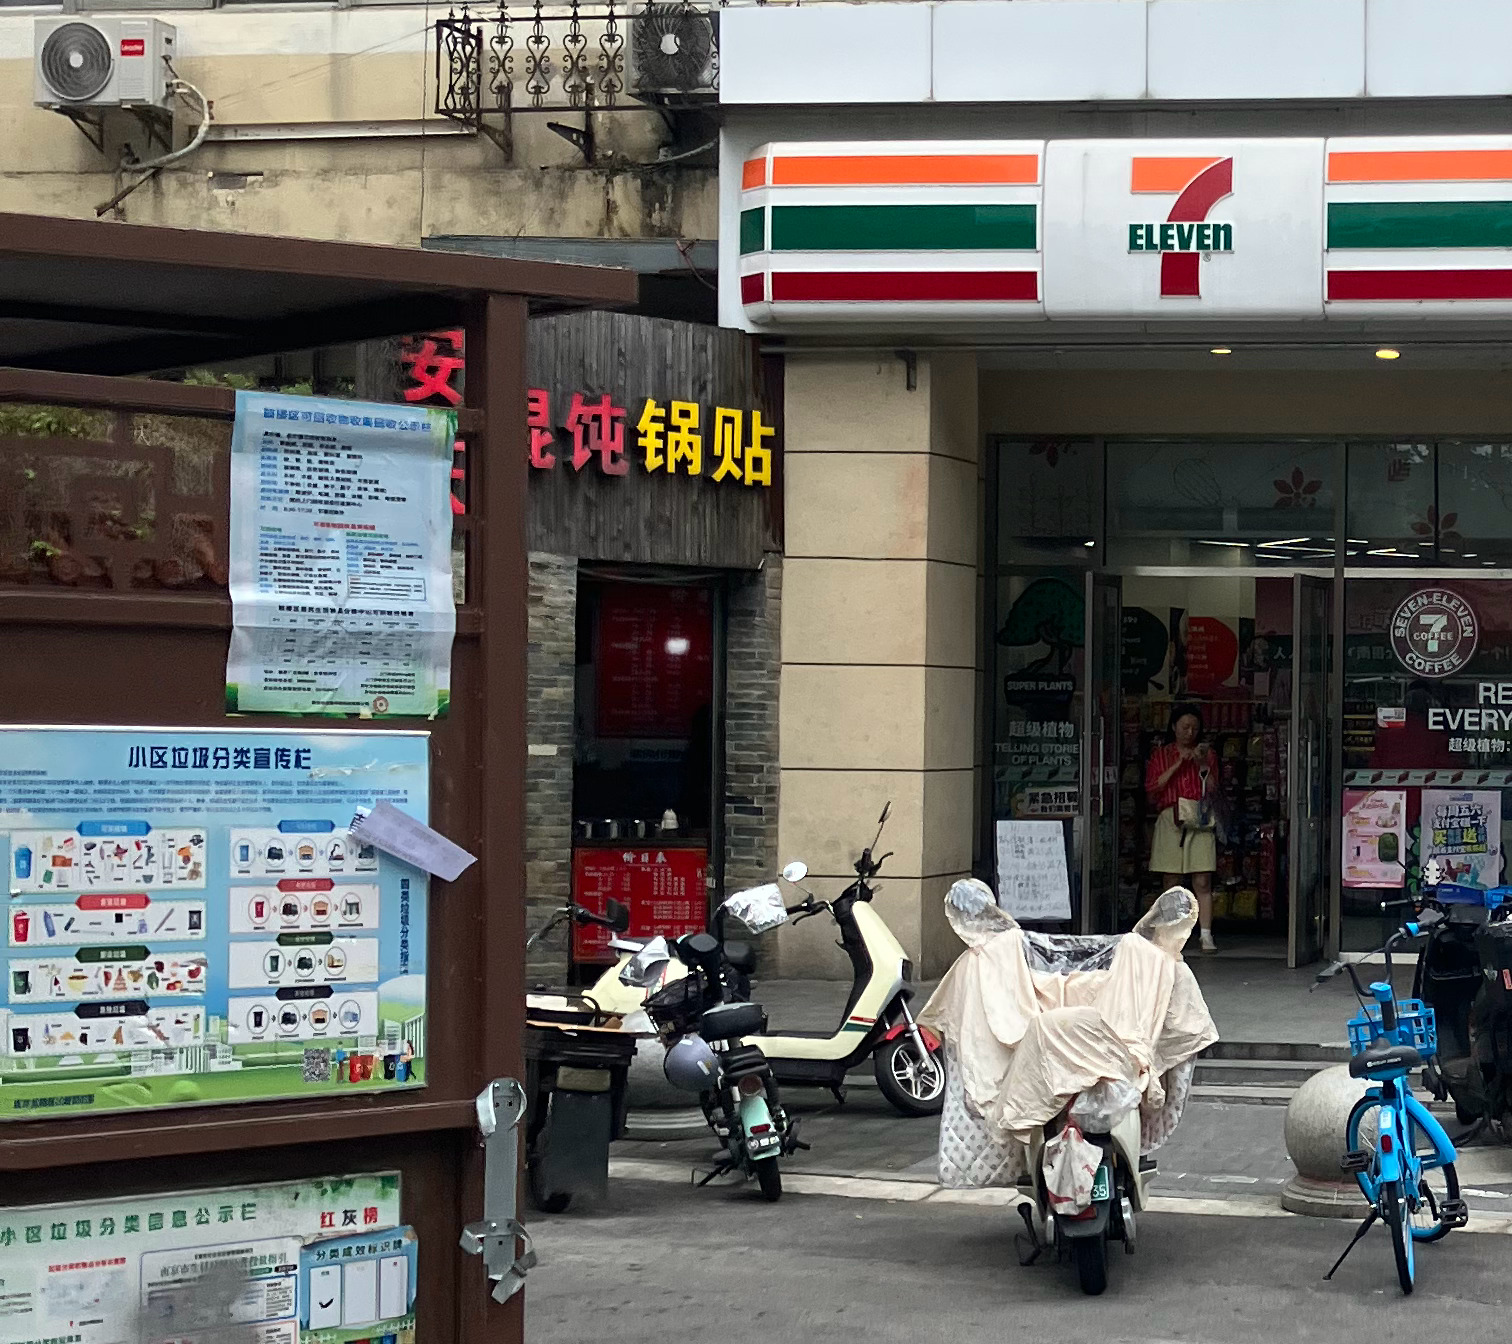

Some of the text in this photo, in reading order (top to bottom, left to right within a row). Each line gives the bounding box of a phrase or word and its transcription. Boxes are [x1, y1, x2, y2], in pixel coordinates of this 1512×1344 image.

[1405, 652, 1463, 674] COFFEE
[1038, 680, 1073, 691] PLANTS
[1008, 720, 1074, 737] 超级植物
[995, 742, 1039, 754] TELLING
[128, 746, 312, 770] 小区垃圾分类宣传栏
[1011, 754, 1072, 766] OF PLANTS
